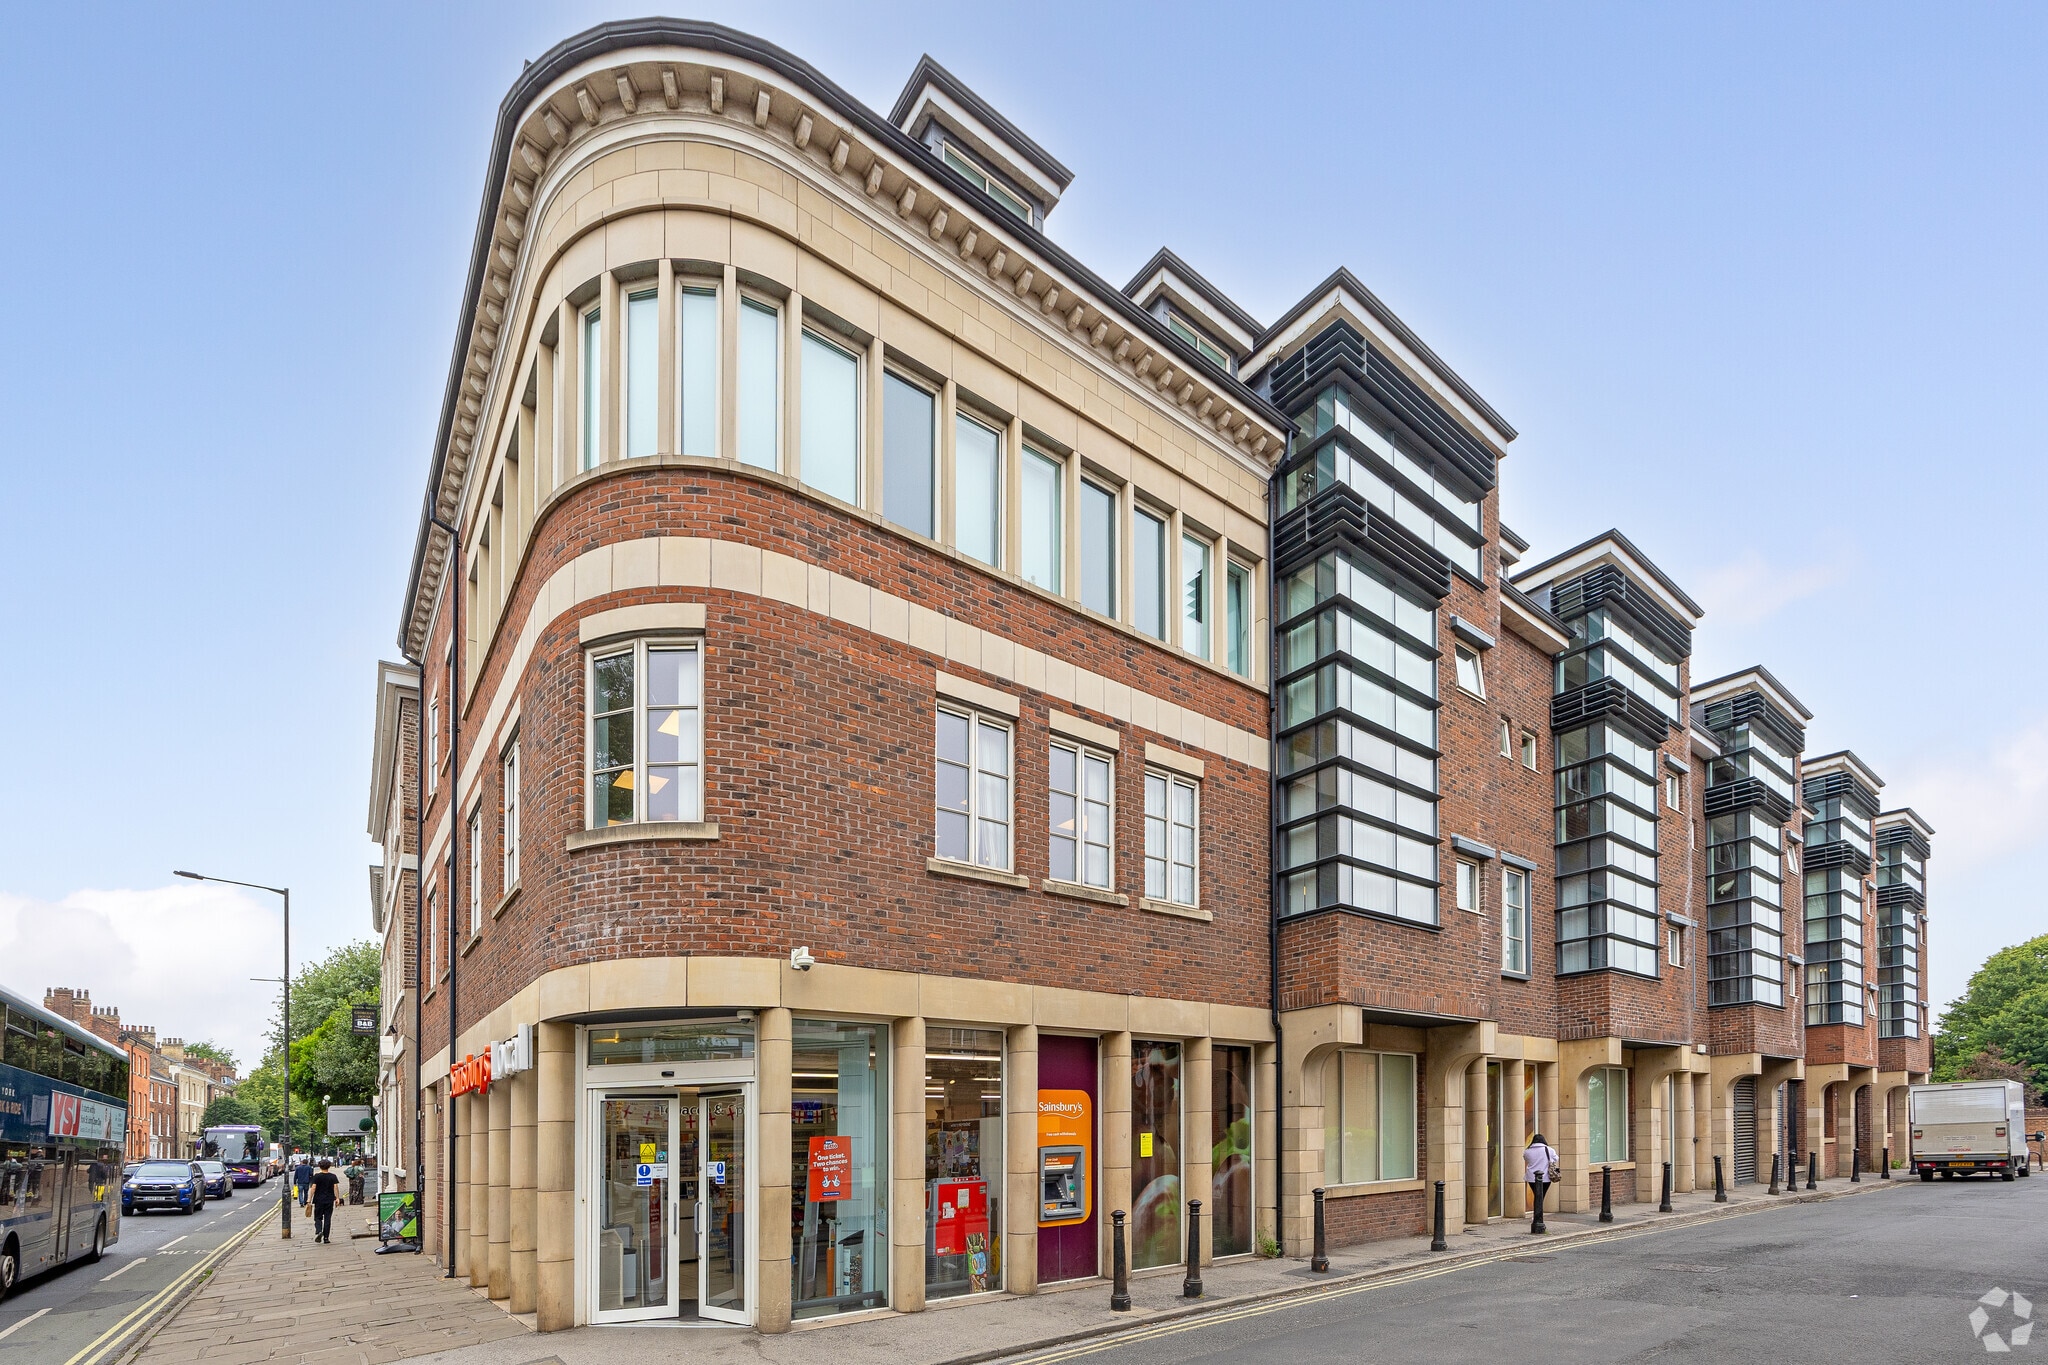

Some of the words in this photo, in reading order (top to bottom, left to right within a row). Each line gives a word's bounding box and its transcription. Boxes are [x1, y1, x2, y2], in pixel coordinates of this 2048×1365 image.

[491, 1023, 533, 1080] Local
[1, 1087, 16, 1097] YORK
[53, 1091, 82, 1136] YSJ
[714, 1102, 724, 1115] &
[1038, 1101, 1083, 1114] Sainsbury's
[829, 1152, 845, 1160] ticket.
